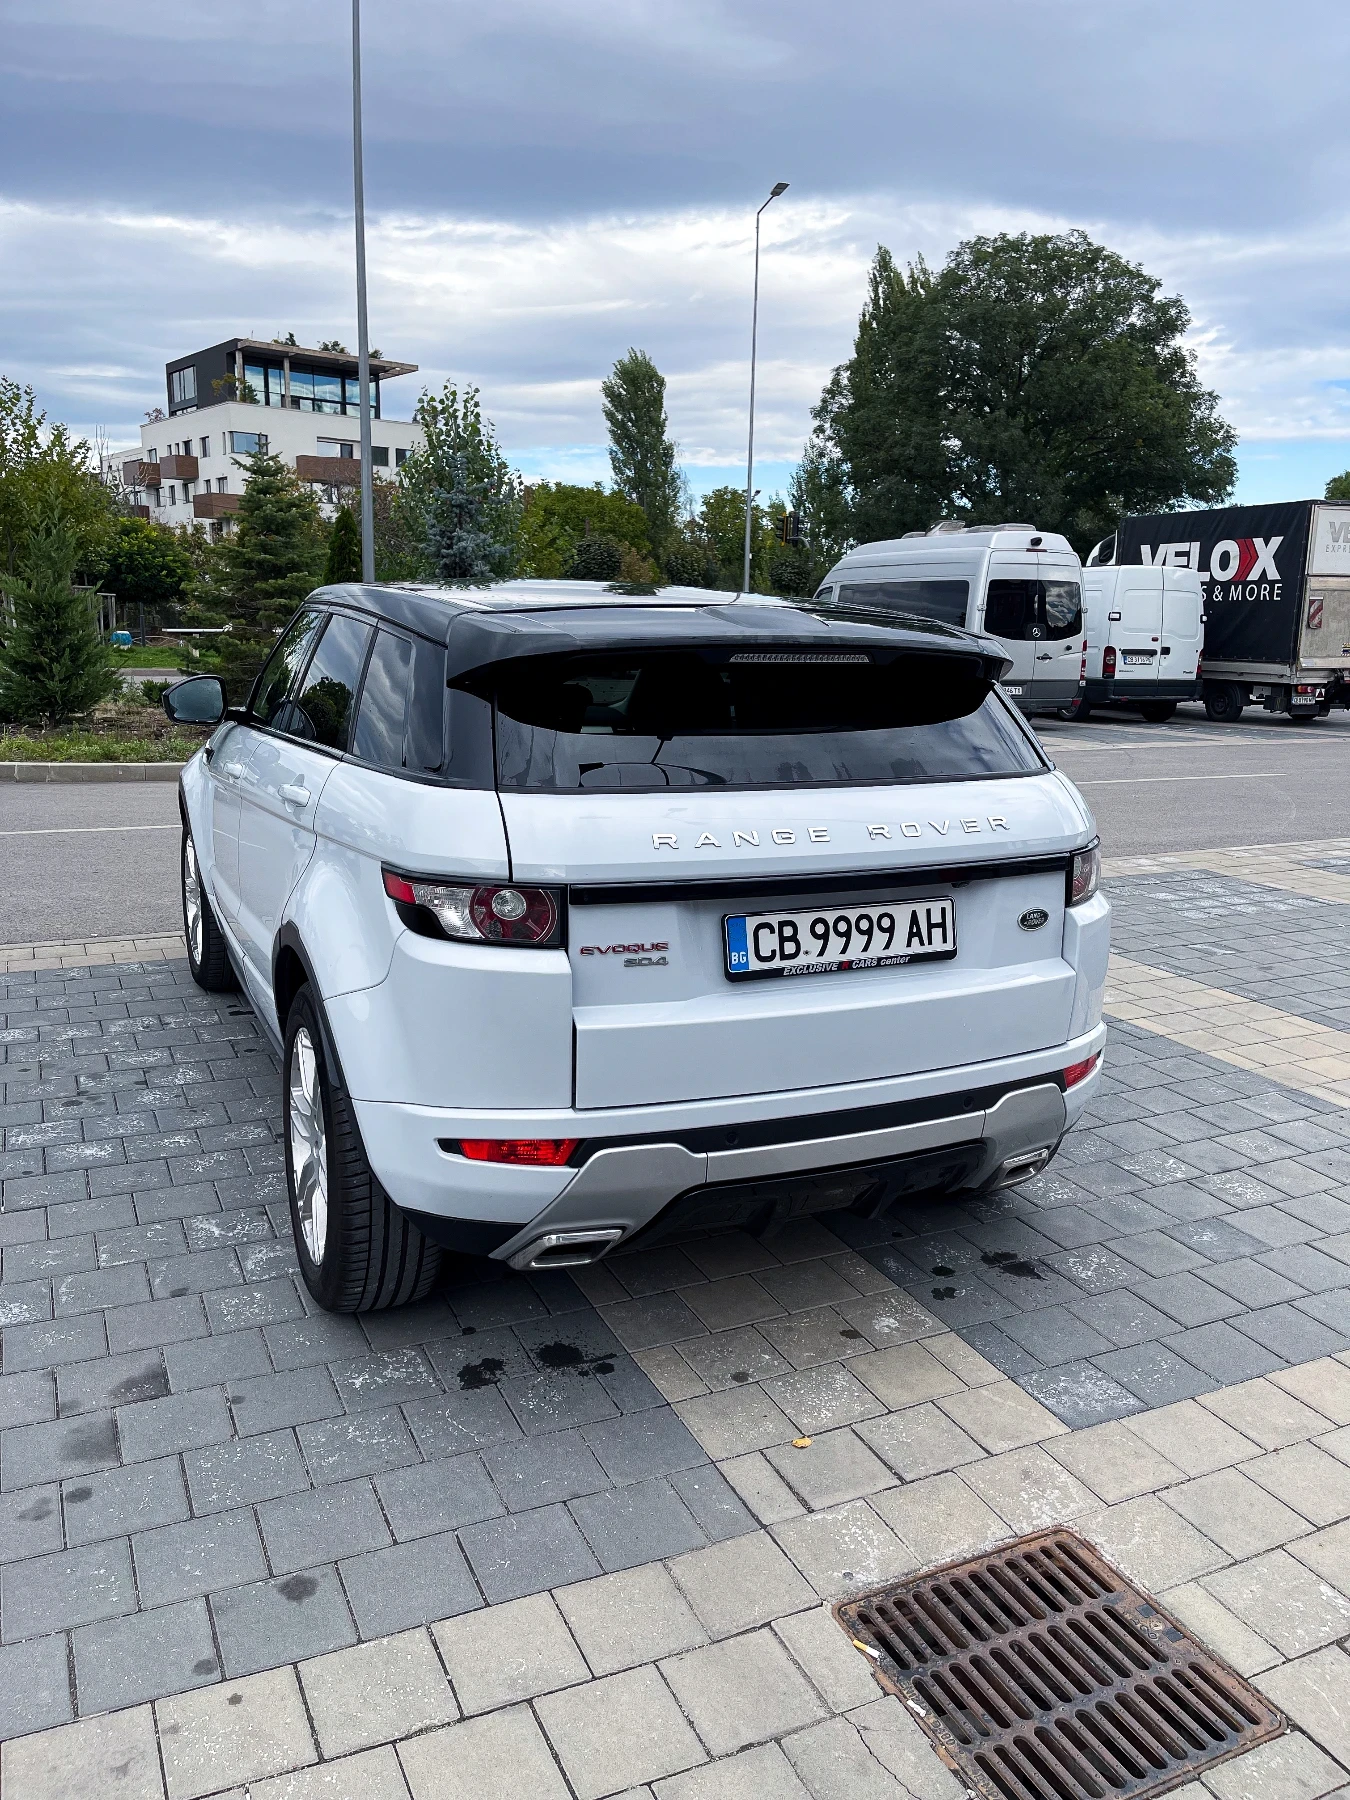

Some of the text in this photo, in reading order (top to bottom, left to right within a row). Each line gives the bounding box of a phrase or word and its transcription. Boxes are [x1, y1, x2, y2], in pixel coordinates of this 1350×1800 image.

[1325, 544, 1350, 553] EXPR
[1213, 585, 1224, 601] &
[1229, 583, 1283, 601] MORE
[652, 815, 1011, 850] RANGE ROVER
[753, 906, 948, 963] CB 9999 AH
[580, 941, 669, 956] EVOQUE
[731, 951, 747, 964] BG
[783, 961, 839, 976] EXCLUSIVE
[852, 957, 878, 969] CARS
[881, 955, 910, 966] center
